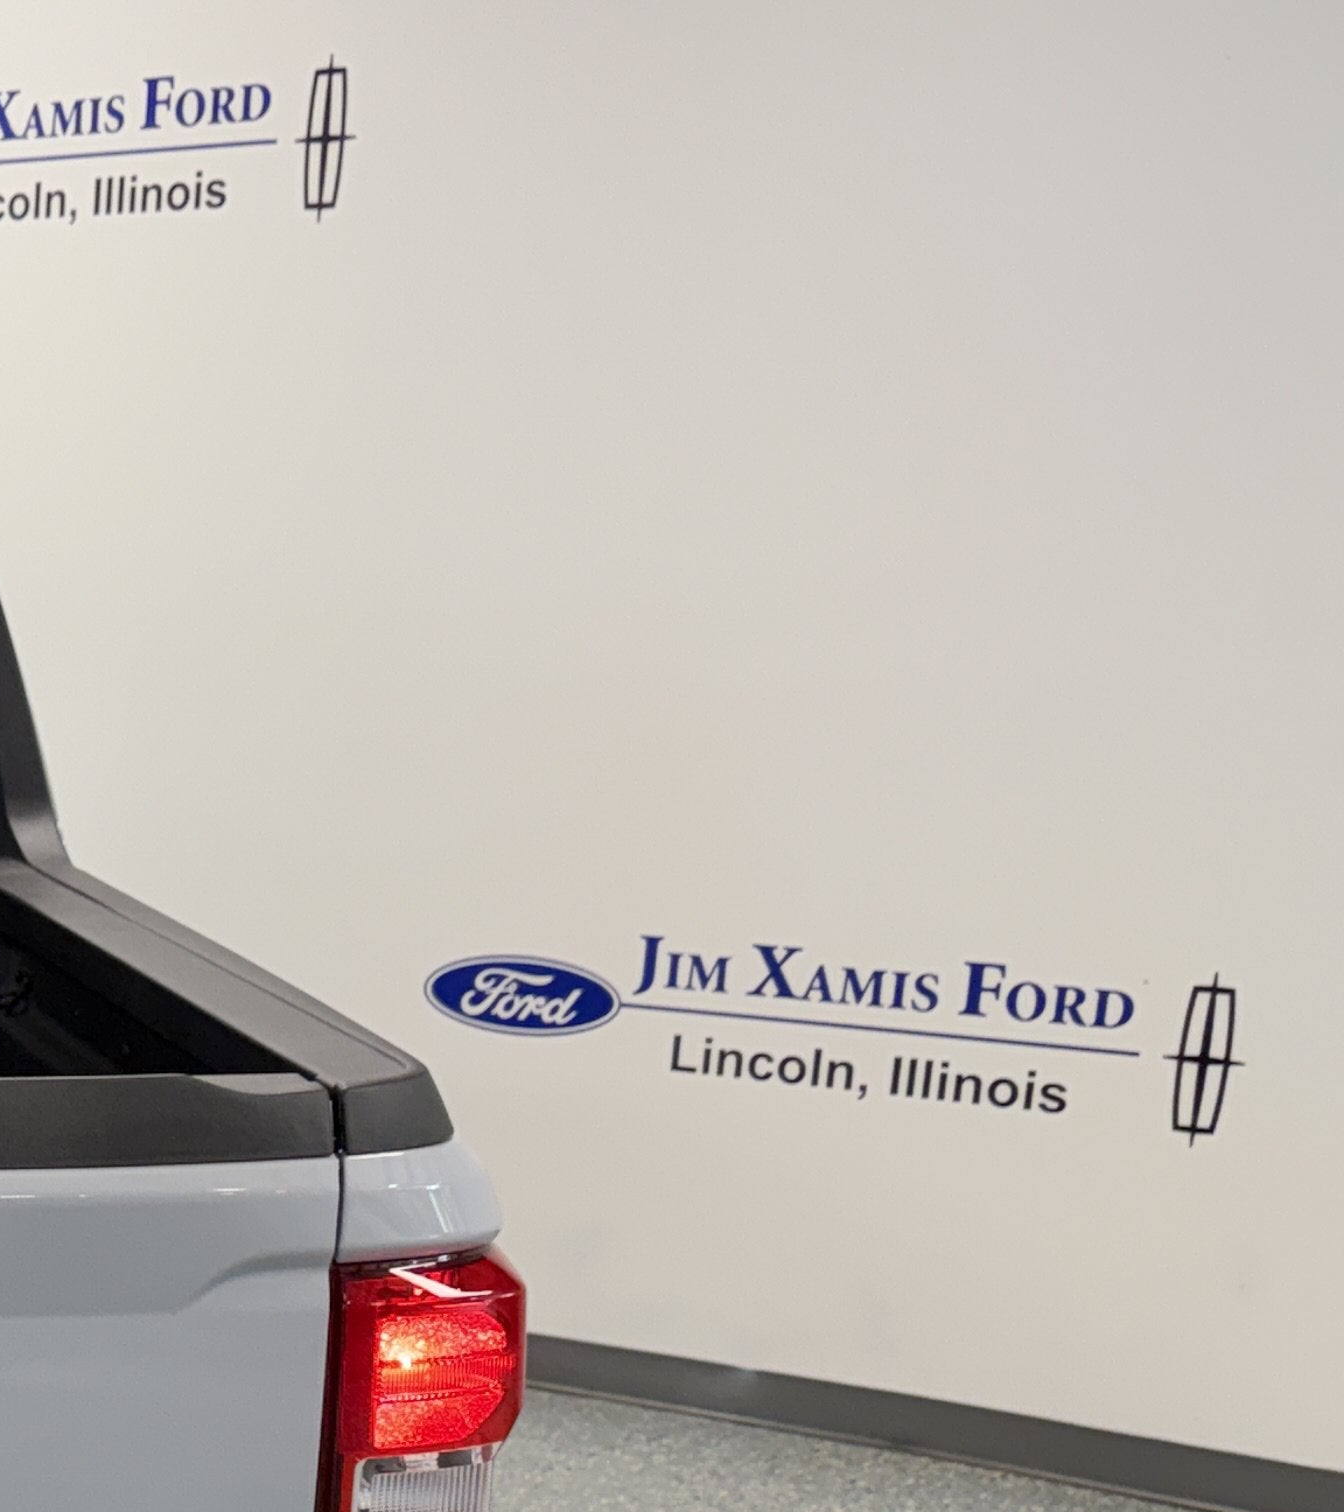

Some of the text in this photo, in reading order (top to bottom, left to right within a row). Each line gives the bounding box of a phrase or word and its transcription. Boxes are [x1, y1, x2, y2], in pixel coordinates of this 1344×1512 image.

[140, 75, 271, 130] FORD
[92, 172, 227, 216] Illinois
[458, 970, 581, 1026] Ford
[633, 934, 1136, 1031] JIM XAMIS FORD
[669, 1033, 1069, 1115] Lincoln, Illinois
